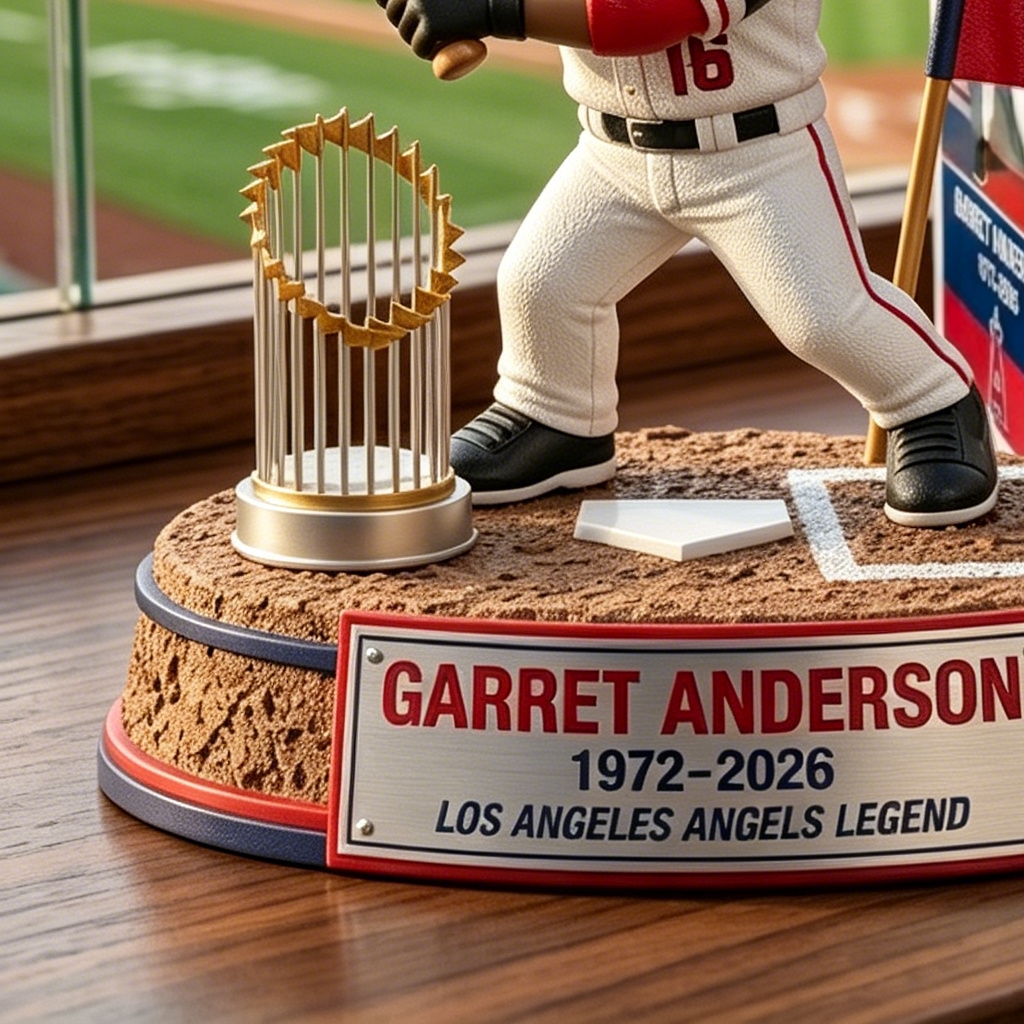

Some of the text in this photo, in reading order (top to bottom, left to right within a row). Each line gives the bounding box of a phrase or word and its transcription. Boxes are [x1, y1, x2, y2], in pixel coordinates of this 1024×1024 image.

[666, 34, 735, 97] 16
[382, 656, 1023, 736] GARRET ANDERSON
[571, 747, 835, 792] 1972-2026
[435, 796, 971, 842] LOS ANGELES ANGELS LEGEND
